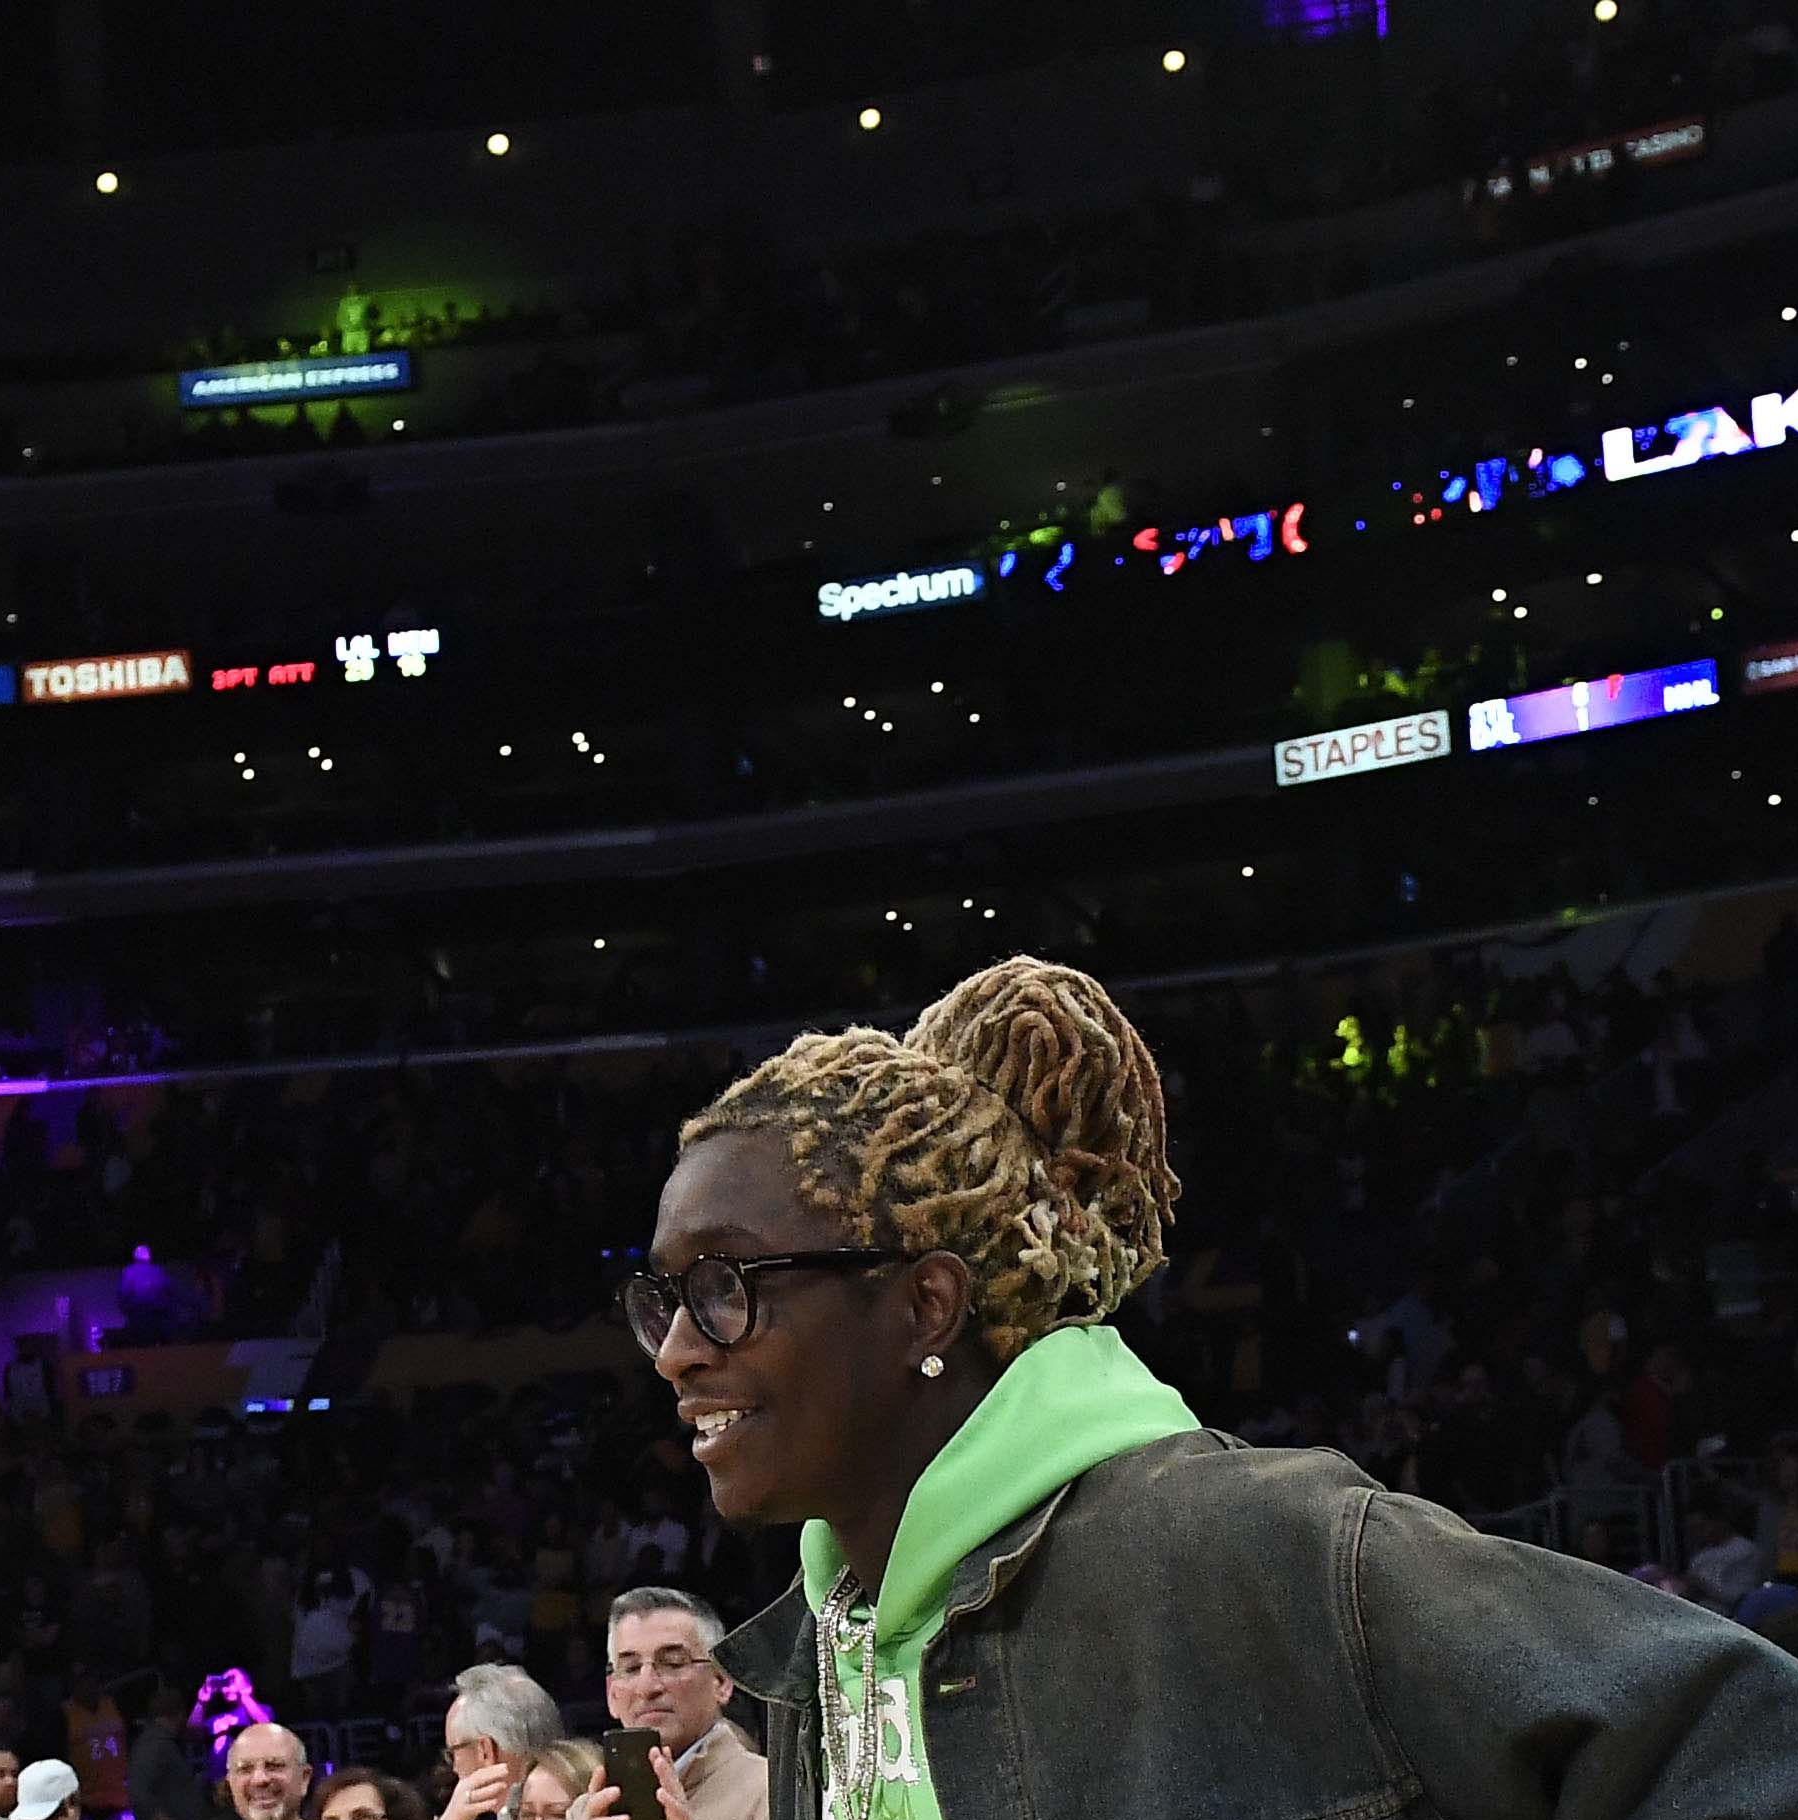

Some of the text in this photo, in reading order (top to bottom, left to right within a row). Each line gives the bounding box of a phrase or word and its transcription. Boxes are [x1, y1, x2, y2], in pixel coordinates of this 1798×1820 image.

[819, 567, 976, 621] Spectrum
[24, 655, 189, 698] TOSHIBA
[1282, 717, 1441, 779] STAPLES
